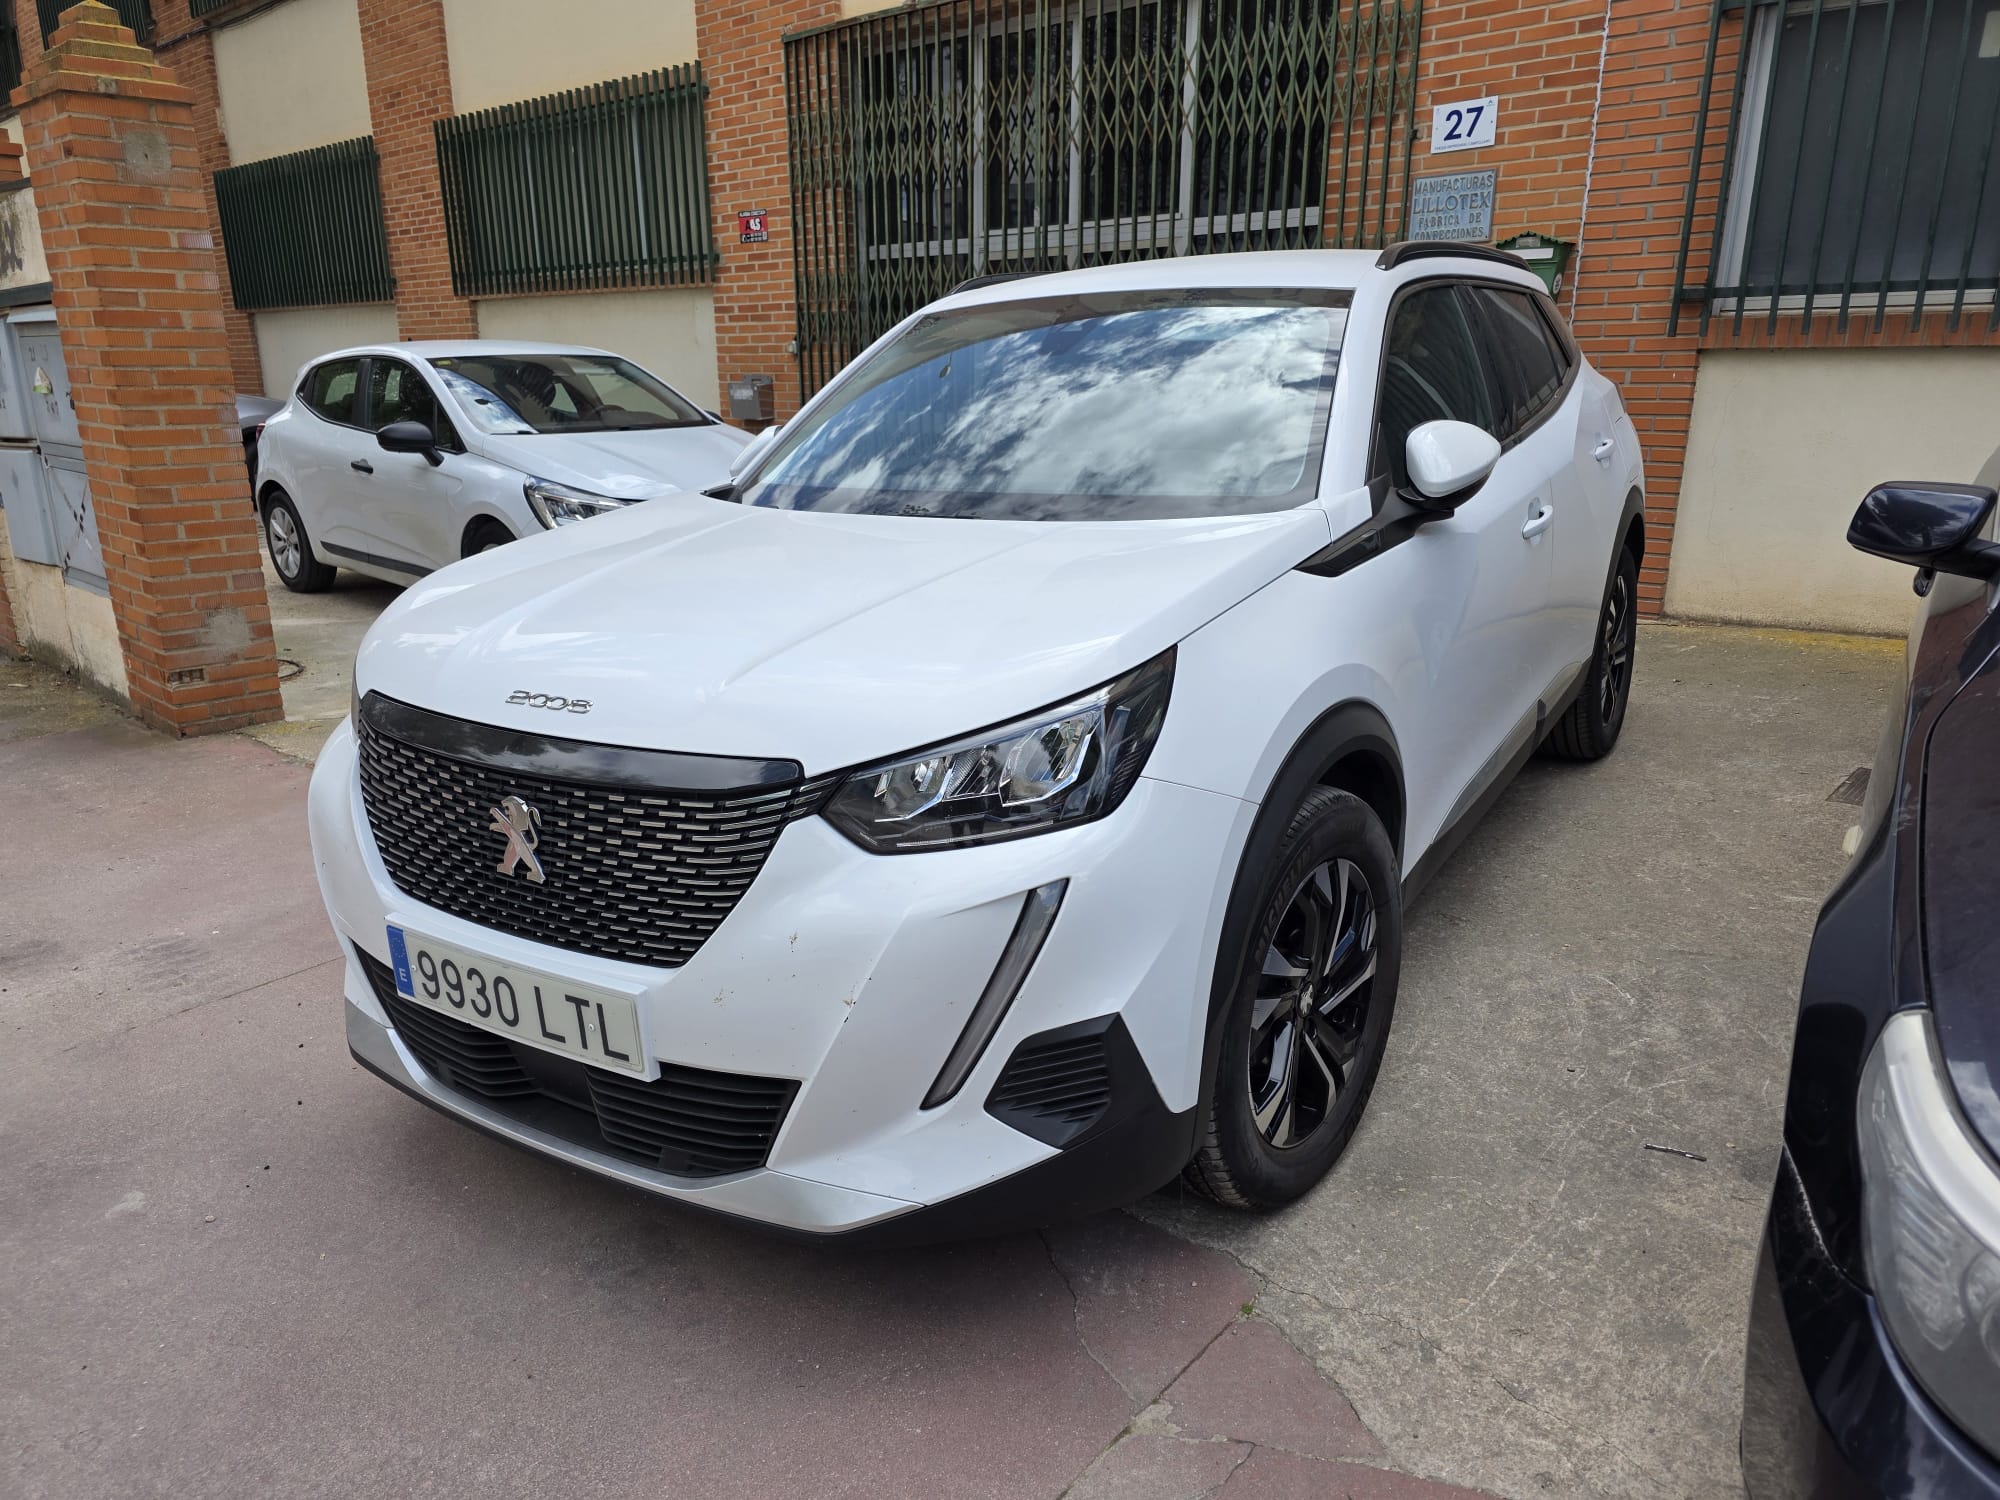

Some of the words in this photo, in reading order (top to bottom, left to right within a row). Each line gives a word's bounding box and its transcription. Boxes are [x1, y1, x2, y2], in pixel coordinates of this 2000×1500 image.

[1444, 105, 1485, 142] 27
[1414, 174, 1493, 196] MANUFACTURAS
[1412, 190, 1492, 214] LILLOTEX
[1418, 215, 1460, 228] FABRICA
[1468, 212, 1482, 224] DE
[505, 689, 594, 714] 2008
[399, 967, 408, 982] E
[417, 950, 520, 1028] 9930
[533, 985, 630, 1062] LTL
